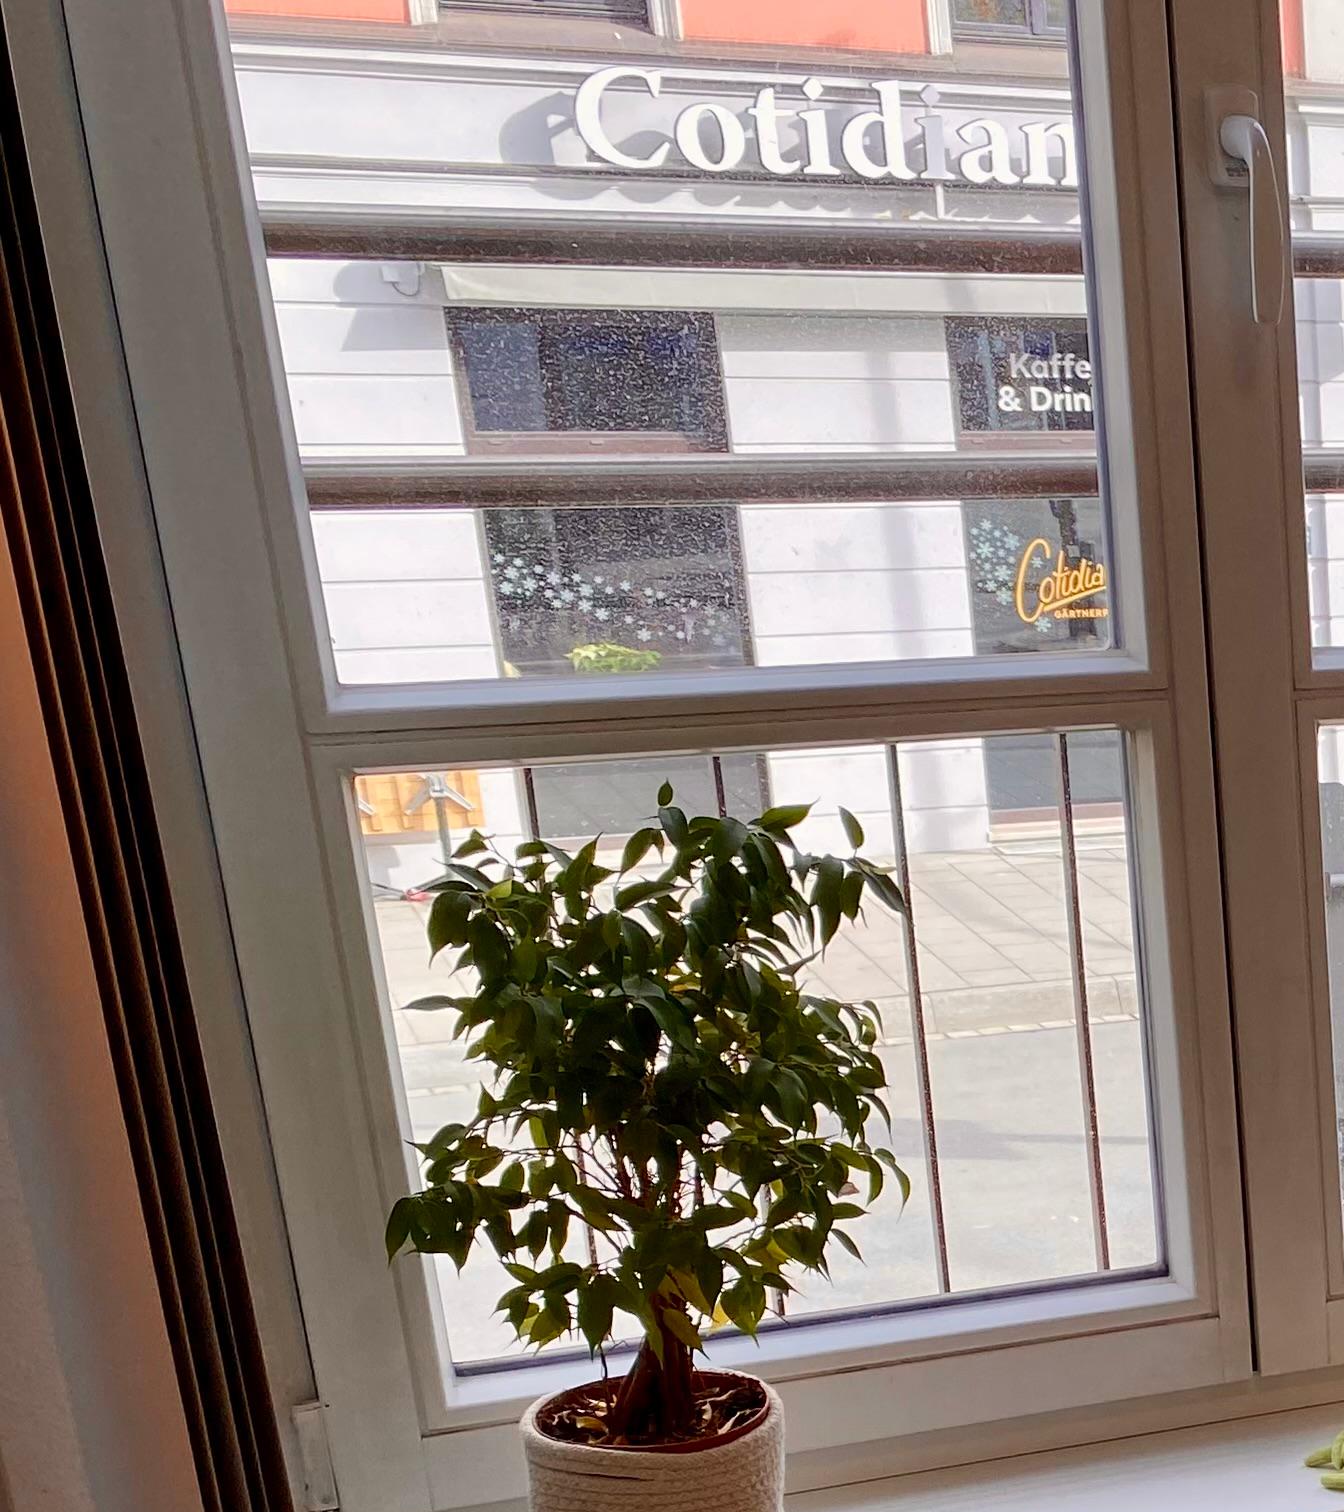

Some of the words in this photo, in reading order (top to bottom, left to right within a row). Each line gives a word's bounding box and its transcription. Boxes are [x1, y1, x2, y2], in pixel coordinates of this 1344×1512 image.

[575, 66, 1079, 186] Cotidian
[1009, 352, 1092, 379] Kaffe
[997, 385, 1023, 412] &
[1029, 385, 1092, 412] Drin
[1016, 538, 1106, 623] Cotidia
